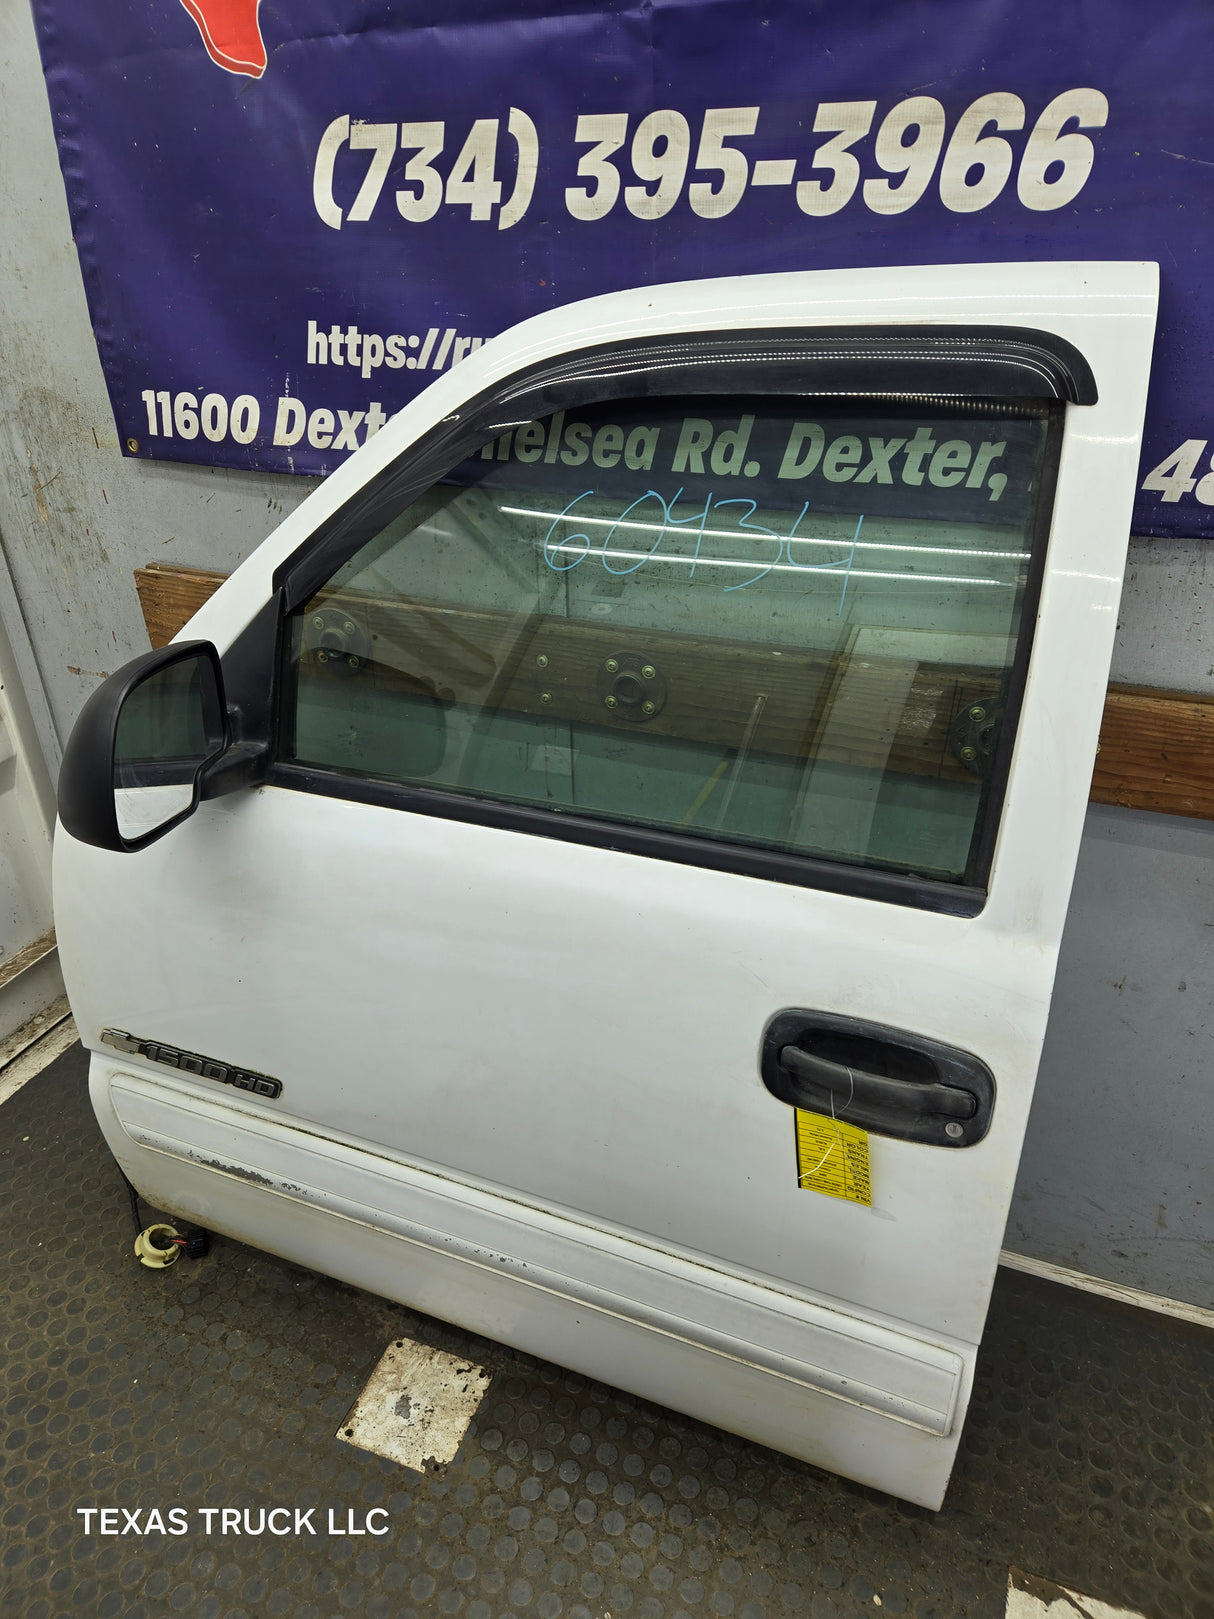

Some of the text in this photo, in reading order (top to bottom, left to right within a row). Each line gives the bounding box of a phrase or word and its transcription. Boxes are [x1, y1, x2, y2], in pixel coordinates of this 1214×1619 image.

[312, 87, 1109, 230] (734) 395-3966
[307, 320, 495, 379] https://r
[142, 389, 260, 445] 11600
[273, 396, 399, 451] Dext
[671, 415, 759, 477] Rd.
[778, 422, 1009, 501] Dexter,
[544, 487, 864, 617] 60434
[146, 1044, 275, 1096] 1500 HD
